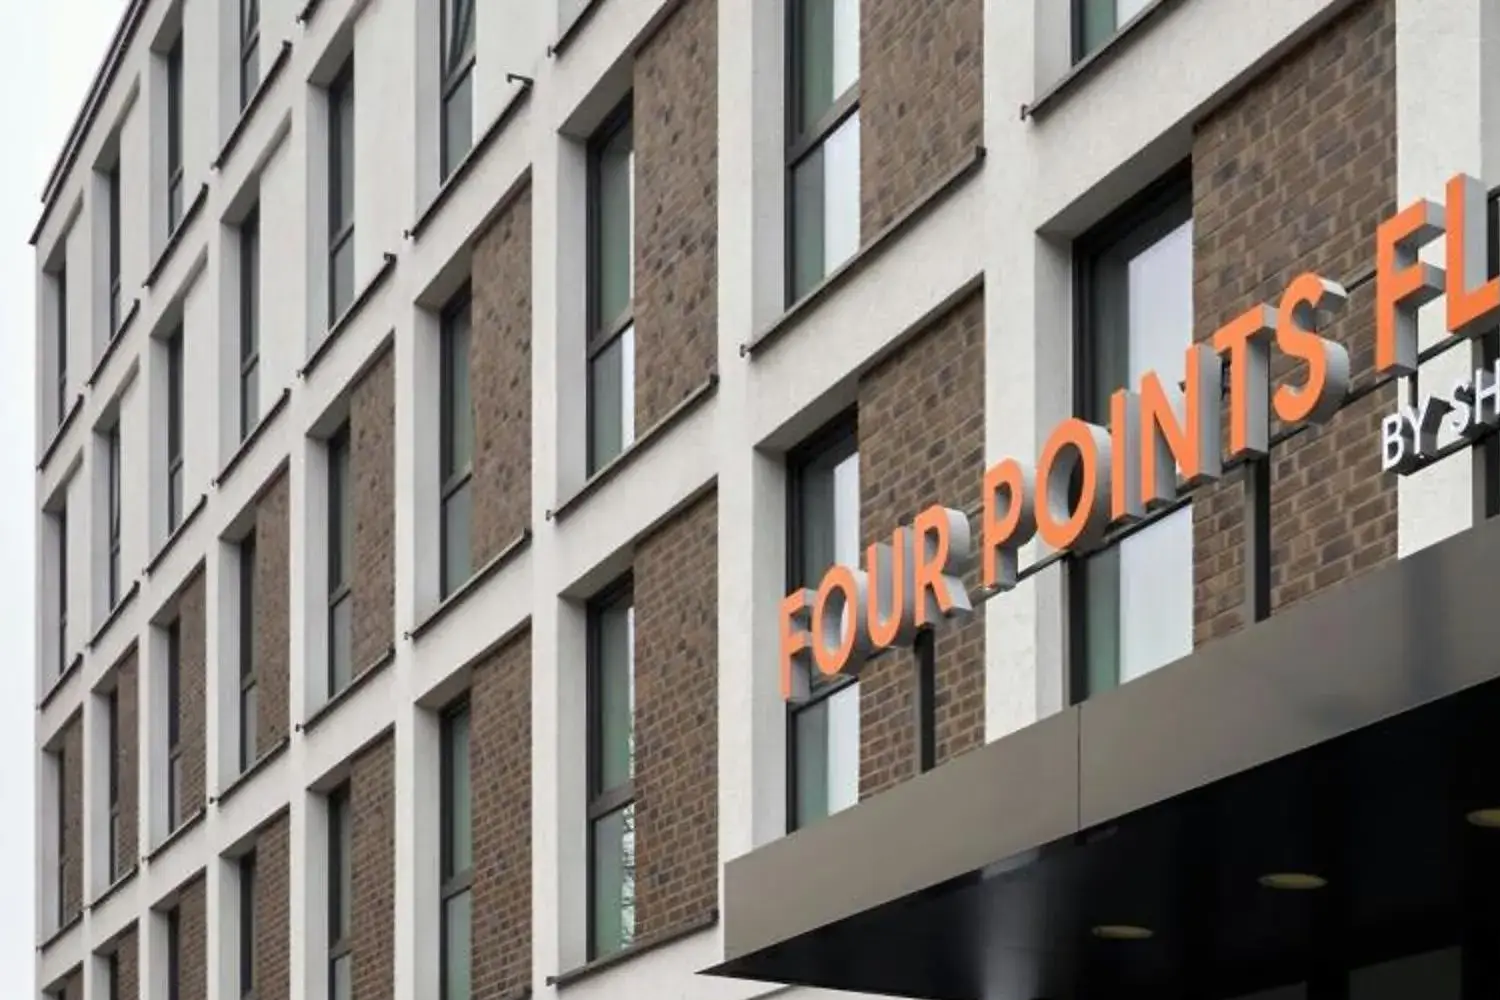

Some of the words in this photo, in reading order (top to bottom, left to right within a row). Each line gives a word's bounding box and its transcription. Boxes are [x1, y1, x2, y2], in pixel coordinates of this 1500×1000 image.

[779, 504, 954, 700] FOUR
[982, 272, 1331, 588] POINTS
[1382, 394, 1432, 471] BY
